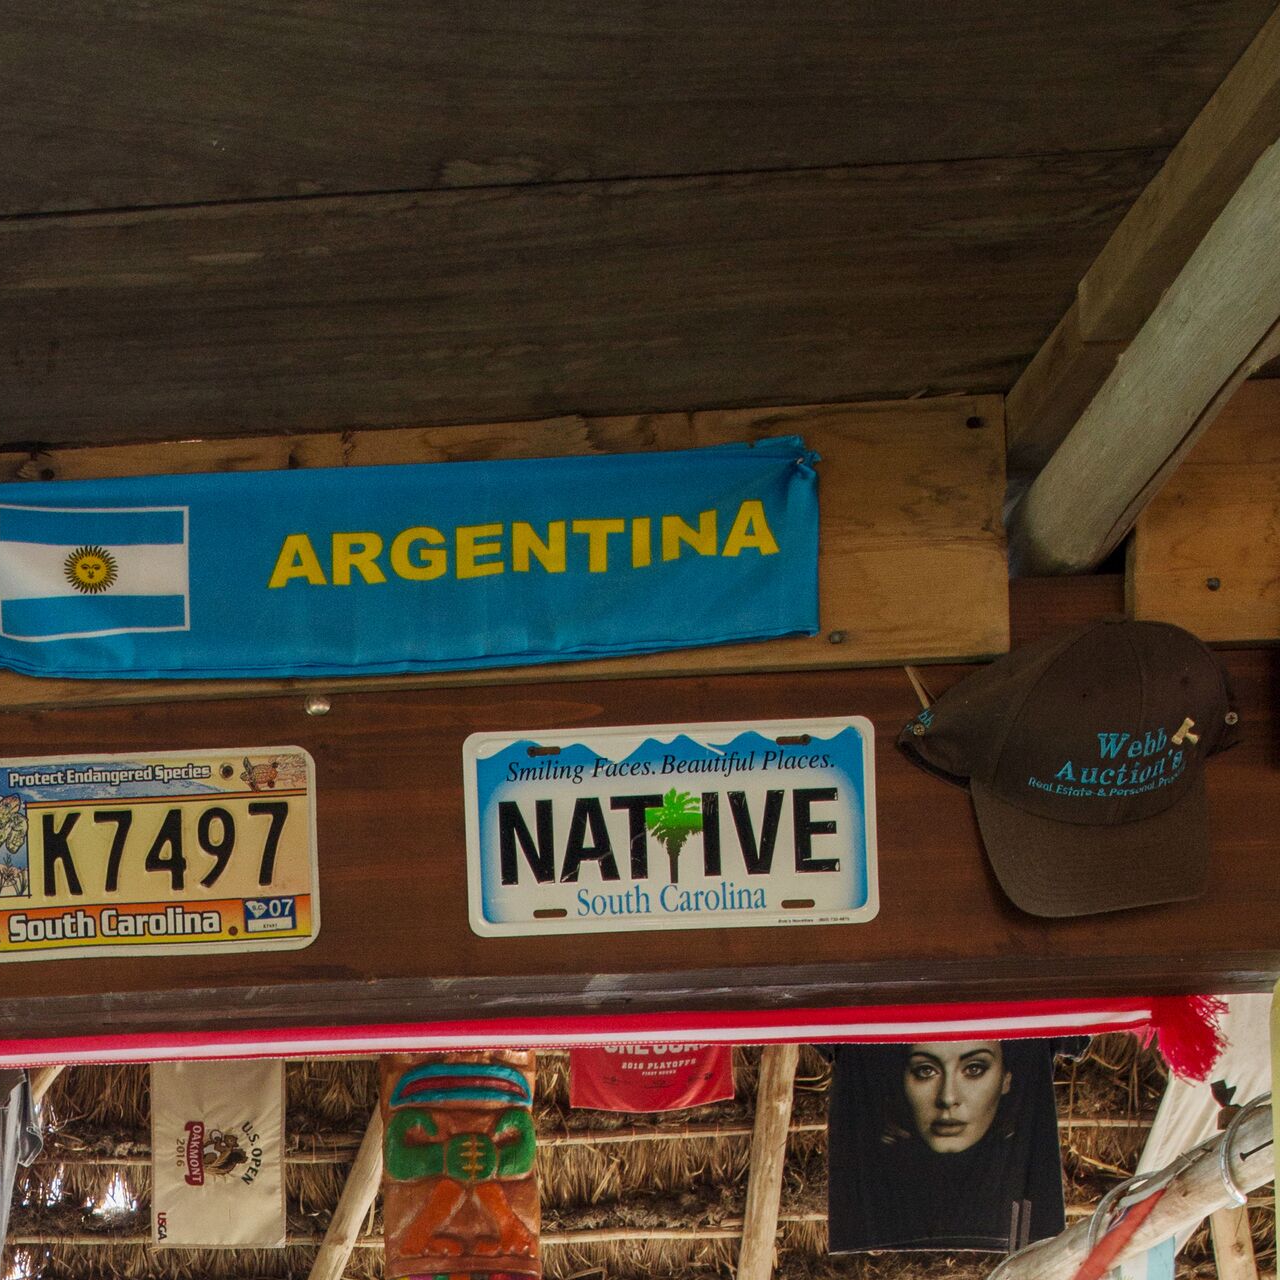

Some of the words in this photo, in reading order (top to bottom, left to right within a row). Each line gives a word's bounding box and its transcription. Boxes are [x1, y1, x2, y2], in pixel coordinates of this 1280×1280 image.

[268, 499, 780, 590] ARGENTINA
[1097, 728, 1167, 759] Webb
[9, 771, 64, 787] Protect
[66, 766, 153, 787] Endangered
[154, 764, 211, 783] Species
[506, 761, 584, 784] Smiling
[592, 758, 656, 778] Faces.
[661, 751, 755, 776] Beautiful
[761, 749, 835, 771] Places.
[1028, 777, 1053, 792] Real
[1056, 784, 1092, 797] Estate
[42, 802, 289, 897] K7497
[498, 787, 841, 887] NATIVE
[269, 899, 294, 917] 07
[577, 886, 650, 917] South
[660, 882, 767, 913] Carolina
[8, 911, 97, 943] South
[100, 908, 220, 938] Carolina
[241, 1121, 260, 1147] U.S.
[176, 1139, 185, 1167] 2016
[189, 1125, 202, 1183] OAKMONT
[241, 1148, 263, 1186] OPEN
[157, 1212, 167, 1241] USGA
